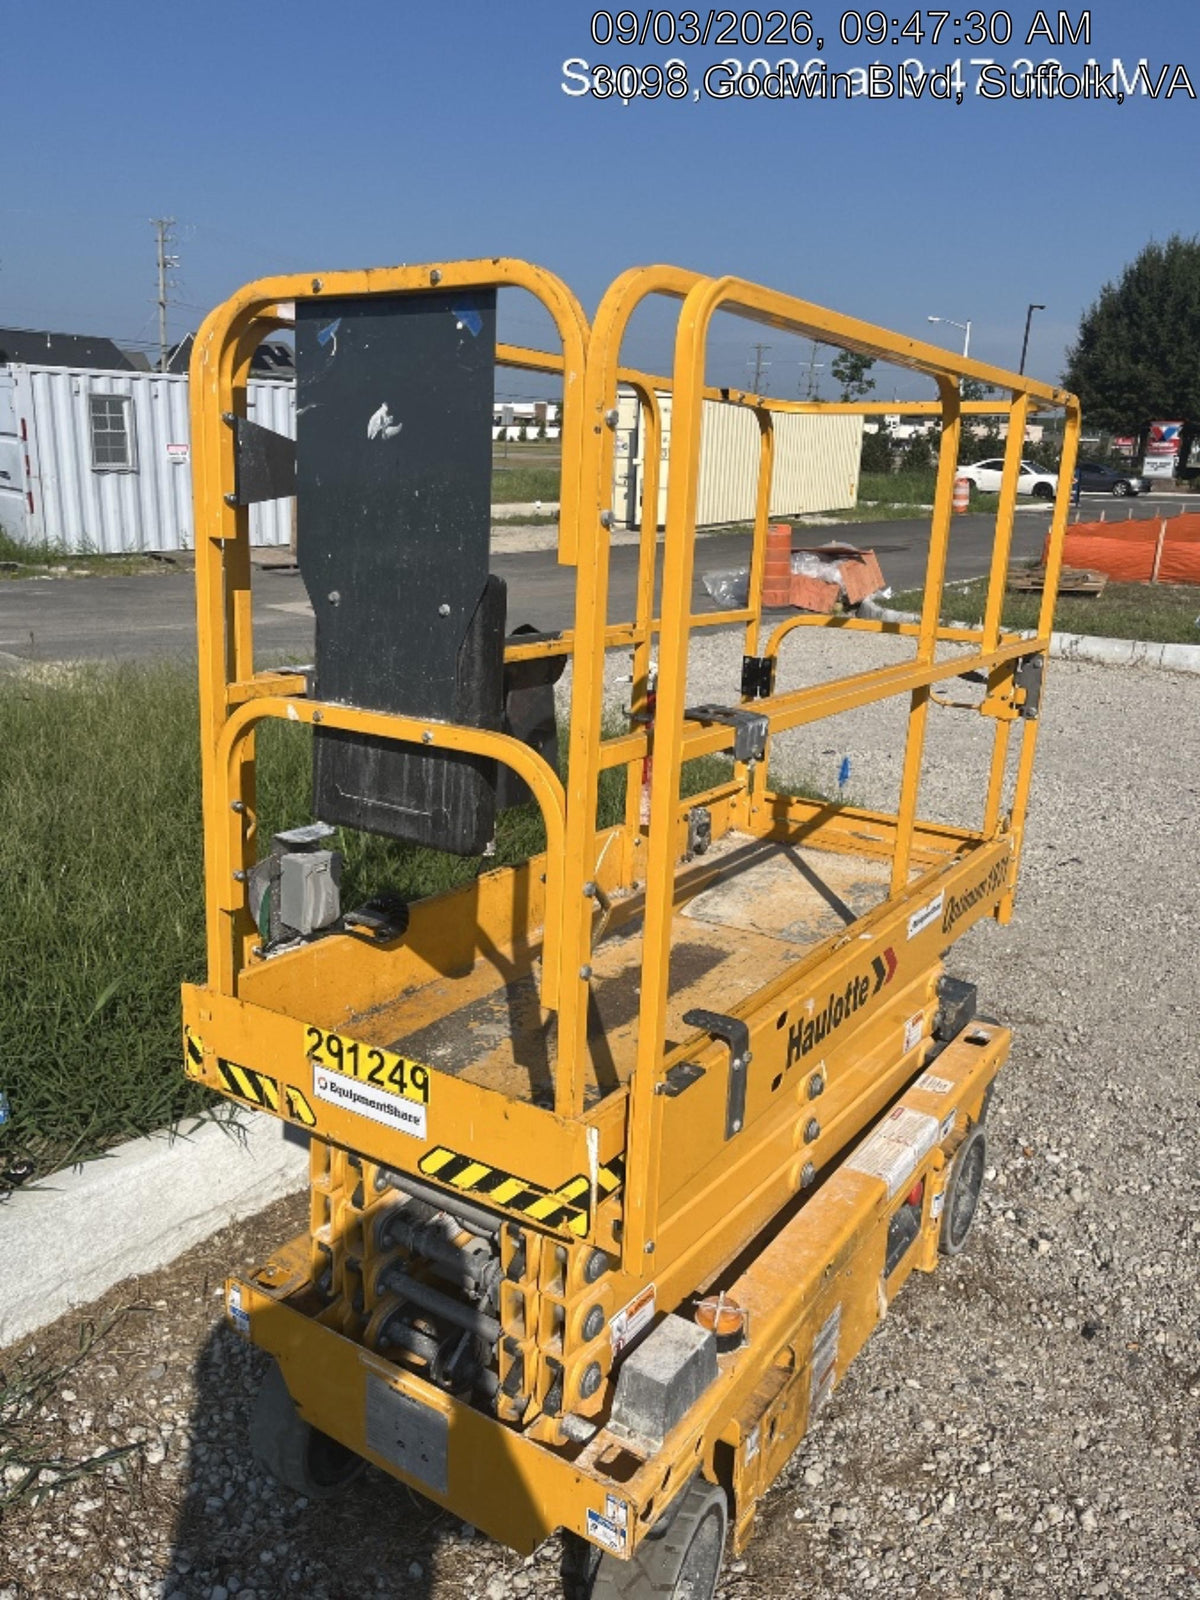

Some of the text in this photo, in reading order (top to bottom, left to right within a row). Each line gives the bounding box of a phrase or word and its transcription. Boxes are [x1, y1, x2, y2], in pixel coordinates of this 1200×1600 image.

[786, 975, 870, 1071] Haulotte
[306, 1026, 430, 1105] 291249
[329, 1081, 422, 1126] EquipmentShare
